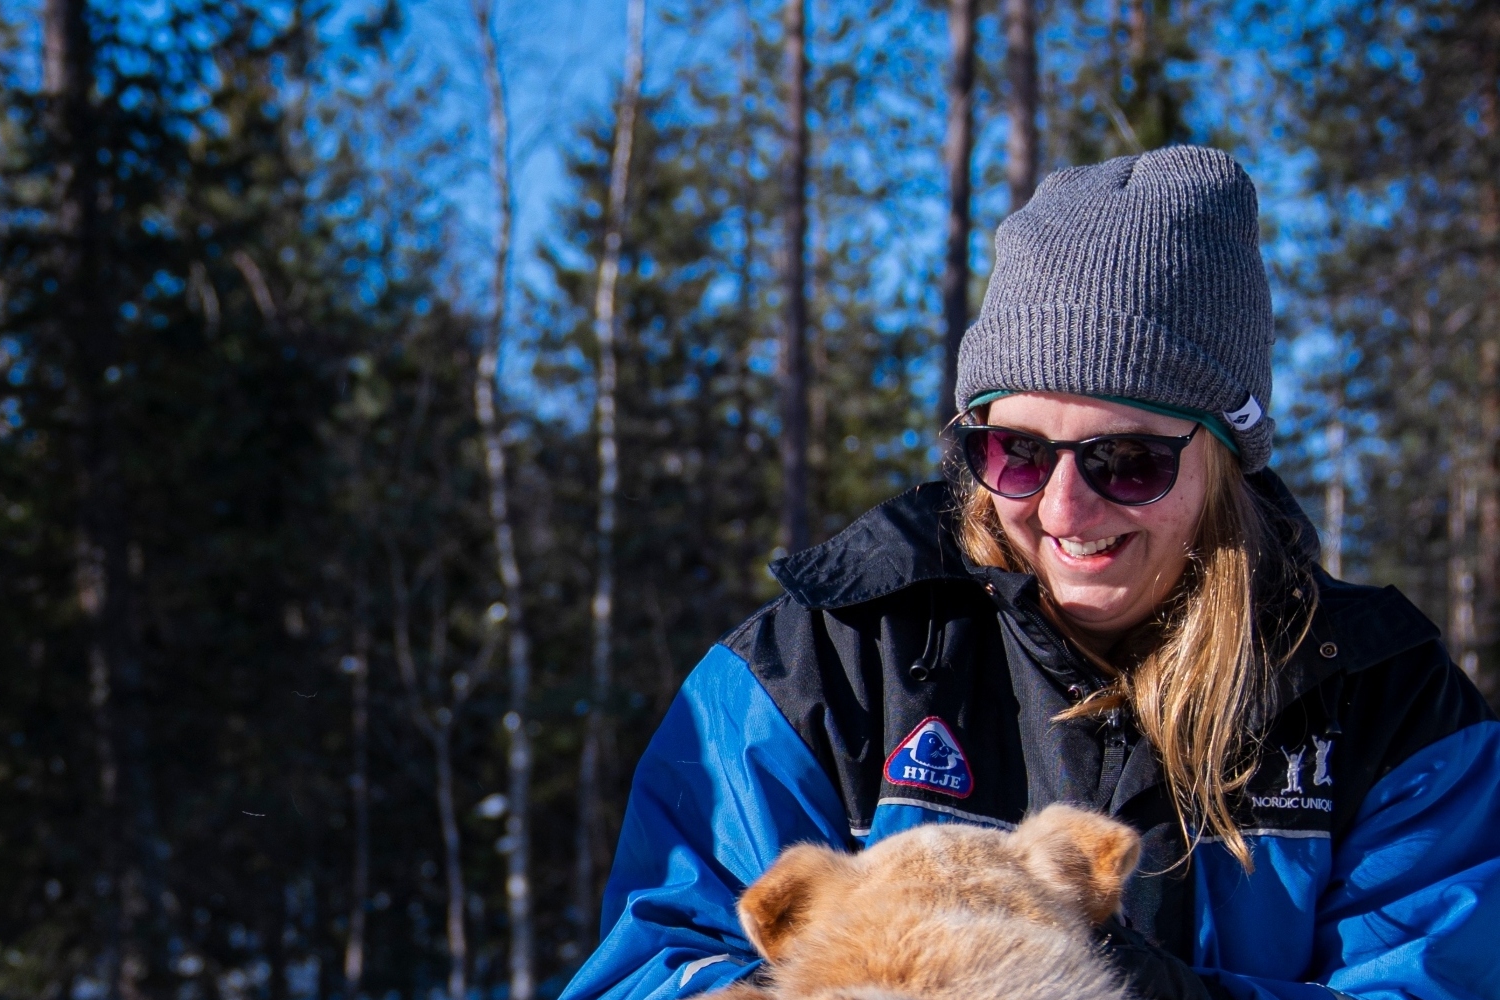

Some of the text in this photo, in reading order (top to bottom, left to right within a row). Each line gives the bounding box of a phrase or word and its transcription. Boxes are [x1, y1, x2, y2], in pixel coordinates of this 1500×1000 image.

[903, 766, 960, 789] HYLJE
[1252, 796, 1332, 812] NORDIC UNIQU
